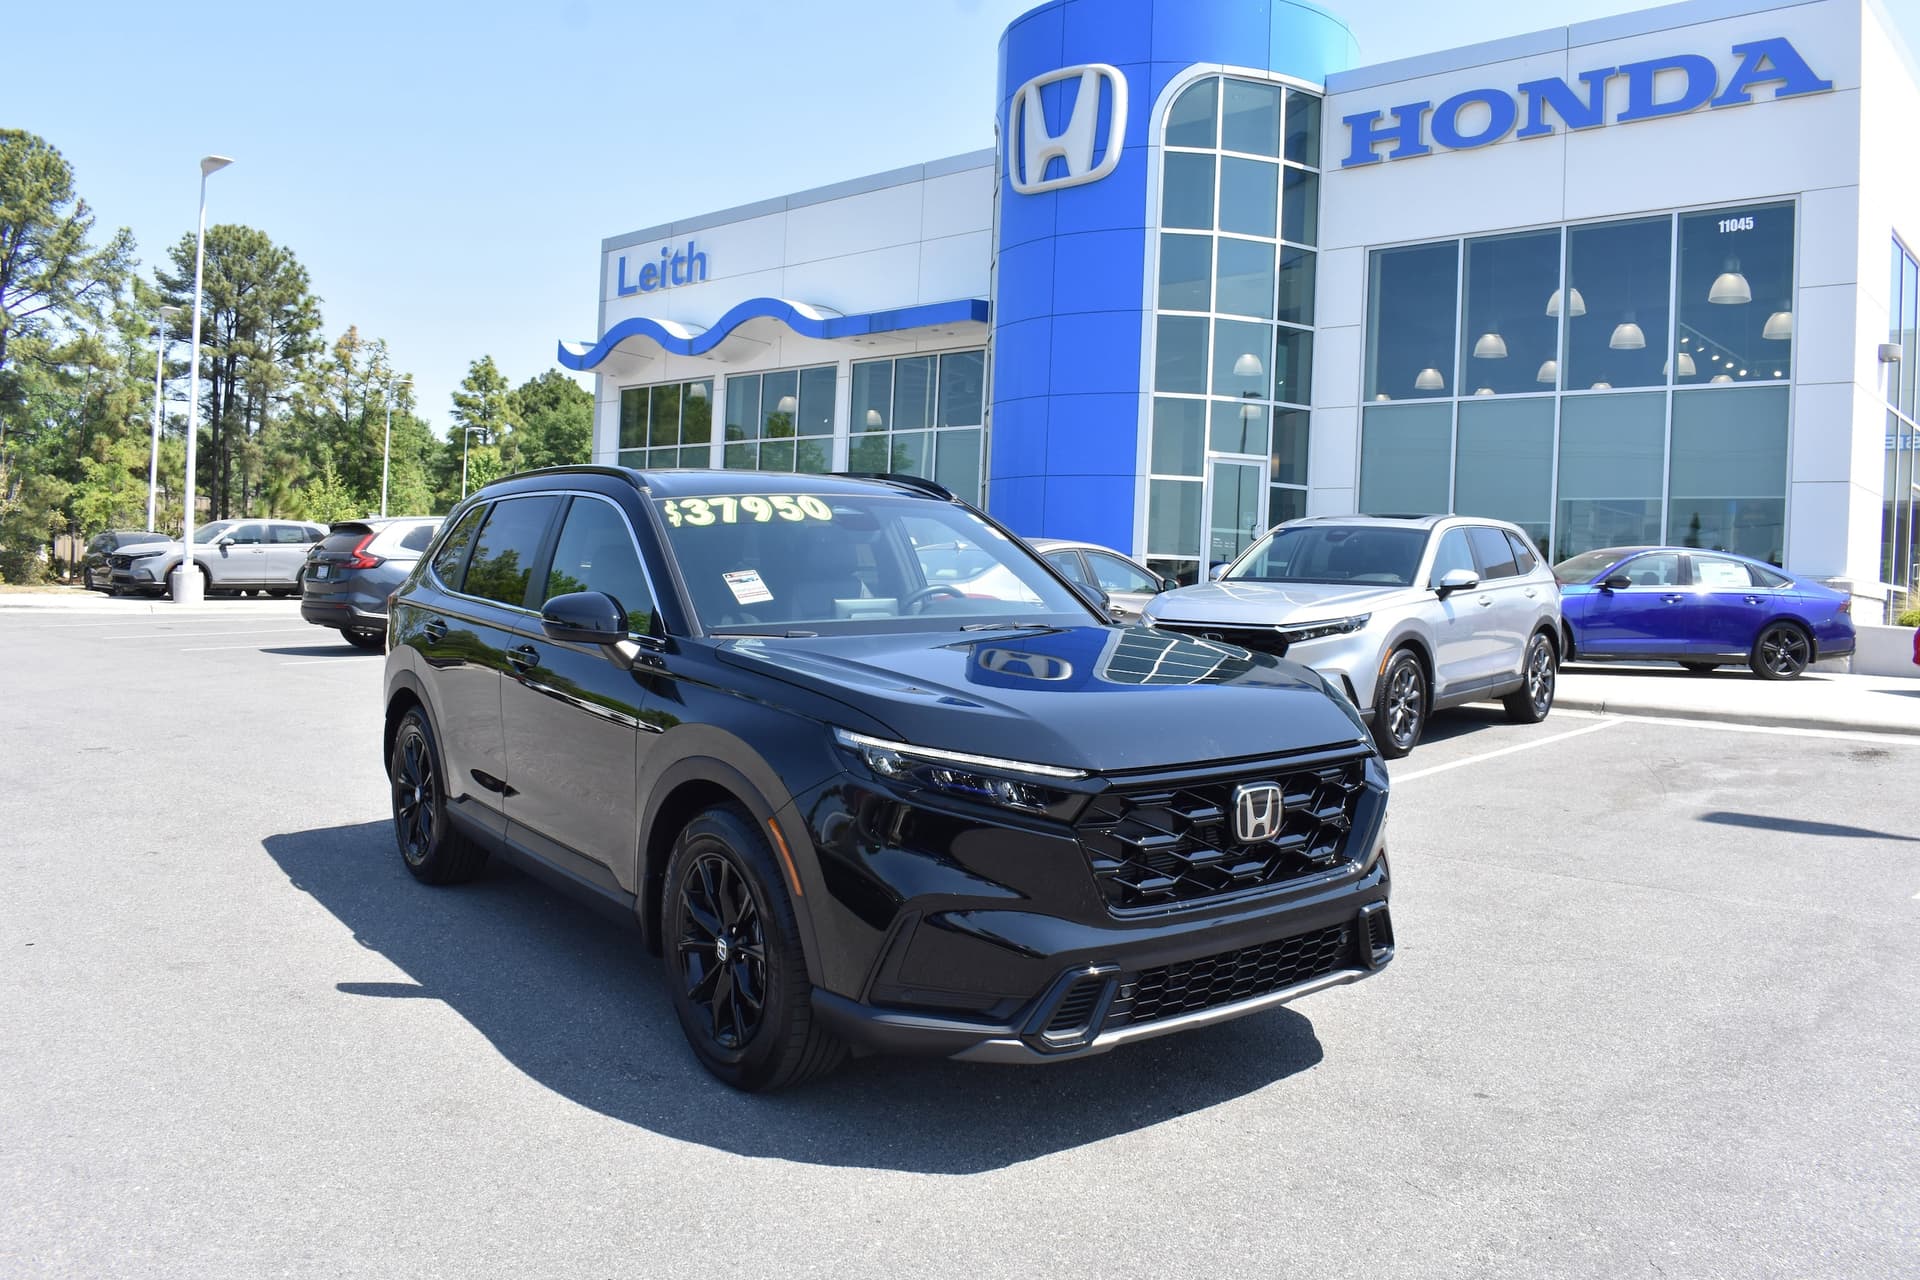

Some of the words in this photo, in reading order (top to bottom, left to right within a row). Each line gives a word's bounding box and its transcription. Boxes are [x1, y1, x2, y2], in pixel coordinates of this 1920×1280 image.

[1341, 36, 1834, 168] HONDA
[1718, 216, 1754, 233] 11045
[618, 240, 707, 297] Leith
[664, 495, 833, 528] $37950
